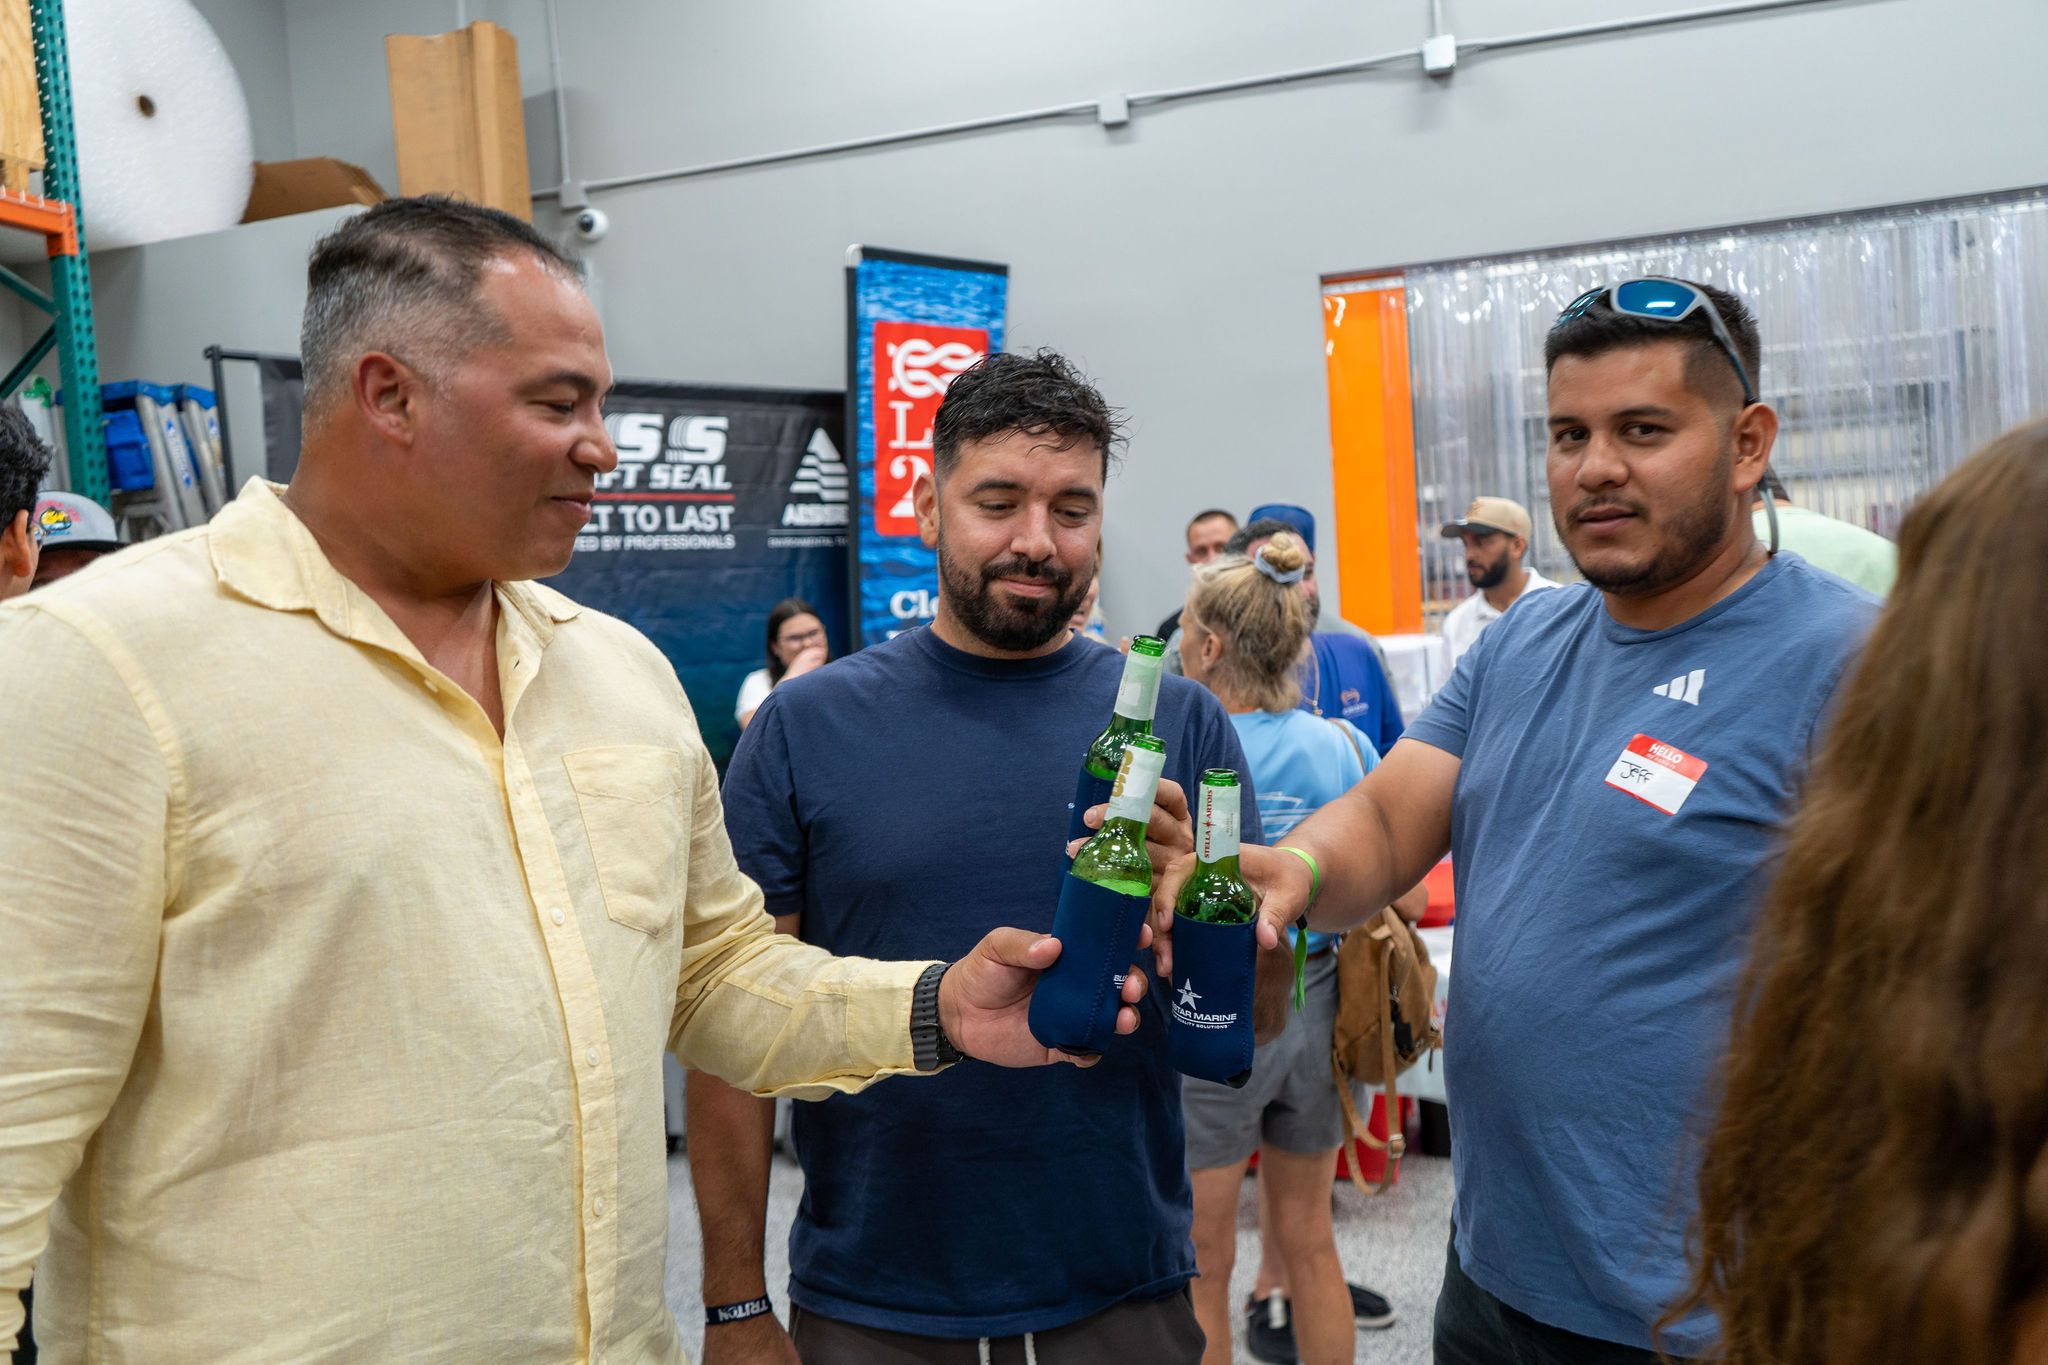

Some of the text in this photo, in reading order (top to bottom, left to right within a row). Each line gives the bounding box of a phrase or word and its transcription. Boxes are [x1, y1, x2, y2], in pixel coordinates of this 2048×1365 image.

[649, 464, 732, 490] SEAL
[618, 504, 661, 532] TO
[665, 505, 734, 531] LAST
[601, 535, 622, 551] BY
[624, 534, 735, 550] PROFESSIONALS
[1649, 743, 1683, 763] HELLO
[1194, 1012, 1237, 1021] MARINE
